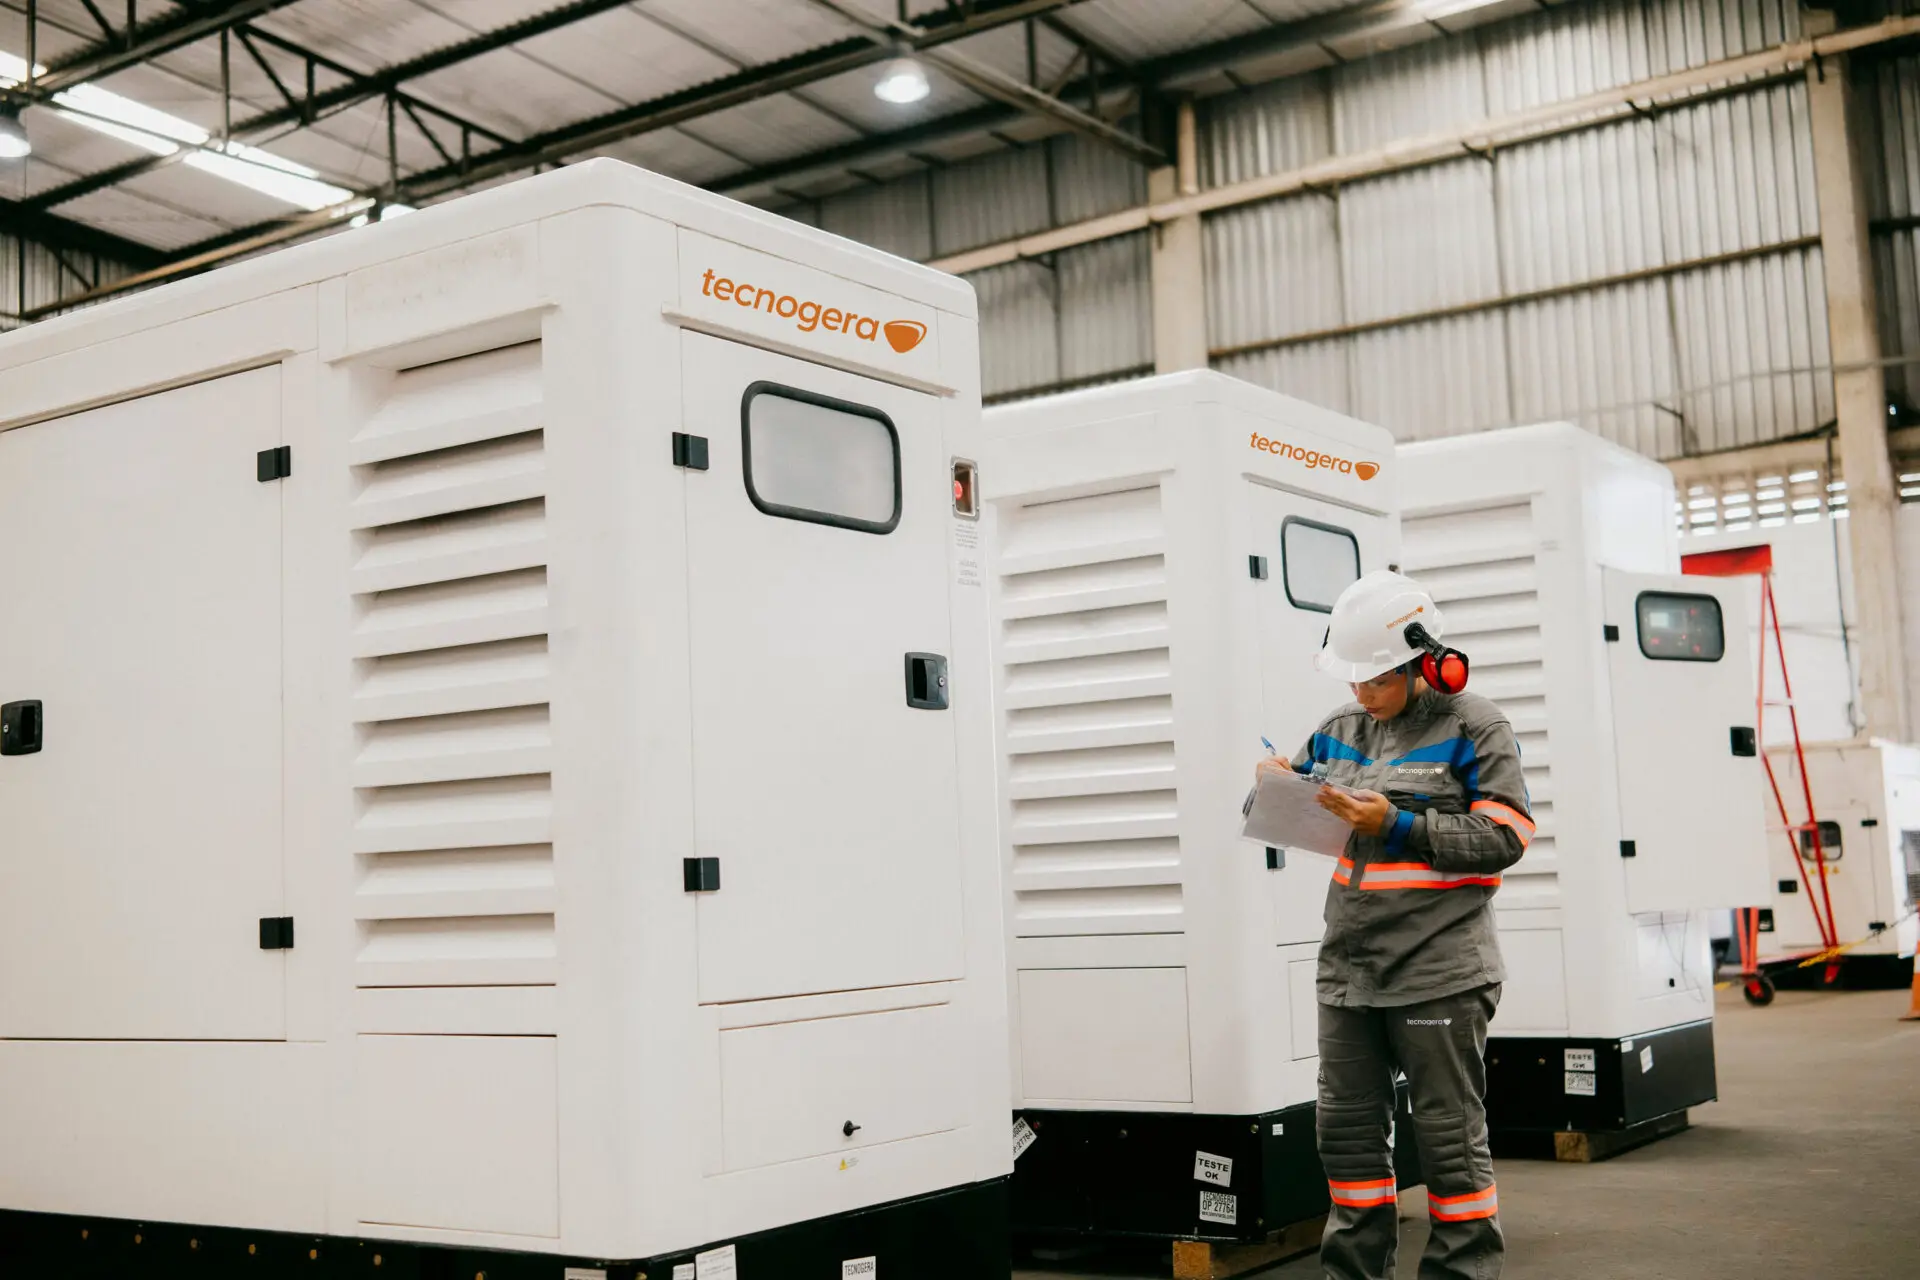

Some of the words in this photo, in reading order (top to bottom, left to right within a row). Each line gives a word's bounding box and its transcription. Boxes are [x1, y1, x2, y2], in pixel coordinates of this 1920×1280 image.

[702, 268, 880, 341] tecnogera
[1250, 432, 1352, 474] tecnogera
[1386, 610, 1418, 629] tecnogera
[1398, 767, 1434, 775] tecnogera
[1406, 1018, 1442, 1026] tecnogera
[1198, 1158, 1229, 1172] TESTE
[1205, 1171, 1218, 1180] OK
[1202, 1200, 1212, 1211] OP
[844, 1261, 874, 1276] TECNOGERA
